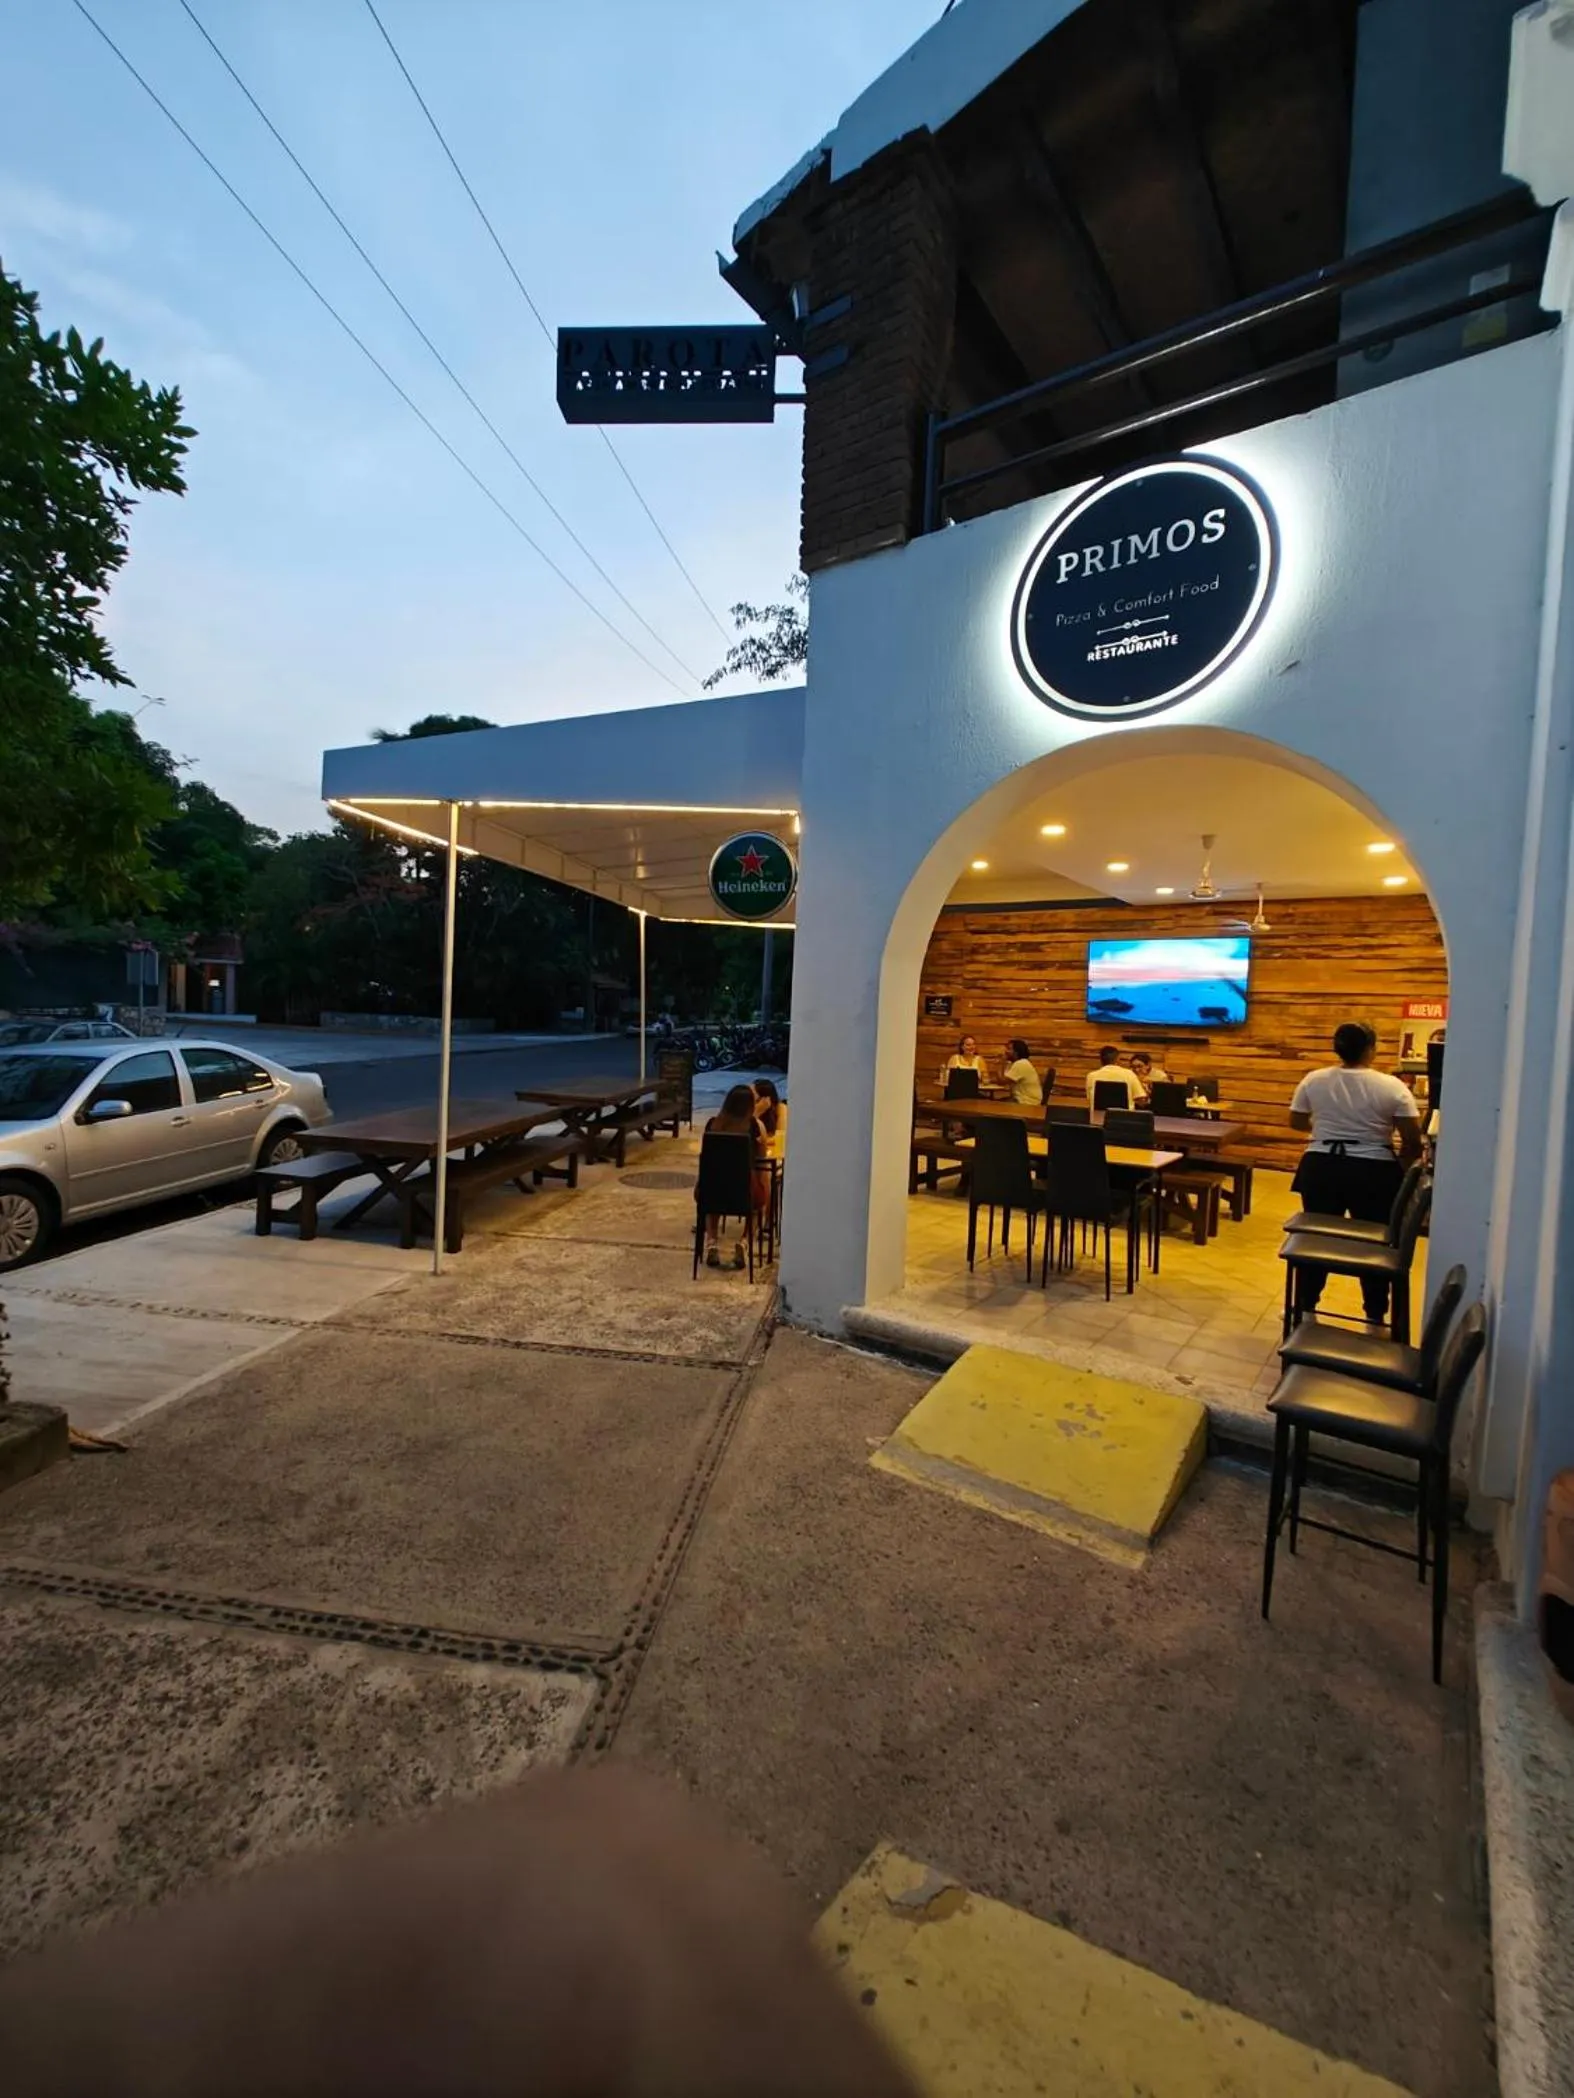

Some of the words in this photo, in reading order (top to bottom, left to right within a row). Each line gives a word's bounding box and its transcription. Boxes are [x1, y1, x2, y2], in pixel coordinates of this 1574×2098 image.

[562, 338, 768, 368] PAROTA
[1055, 508, 1227, 584] PRIMOS
[1056, 613, 1091, 627] Pizza
[1097, 603, 1107, 617] &
[1114, 588, 1174, 613] Comfort
[1180, 574, 1220, 598] Food
[1086, 634, 1180, 662] RESTAURANTE
[718, 879, 786, 893] Heineken
